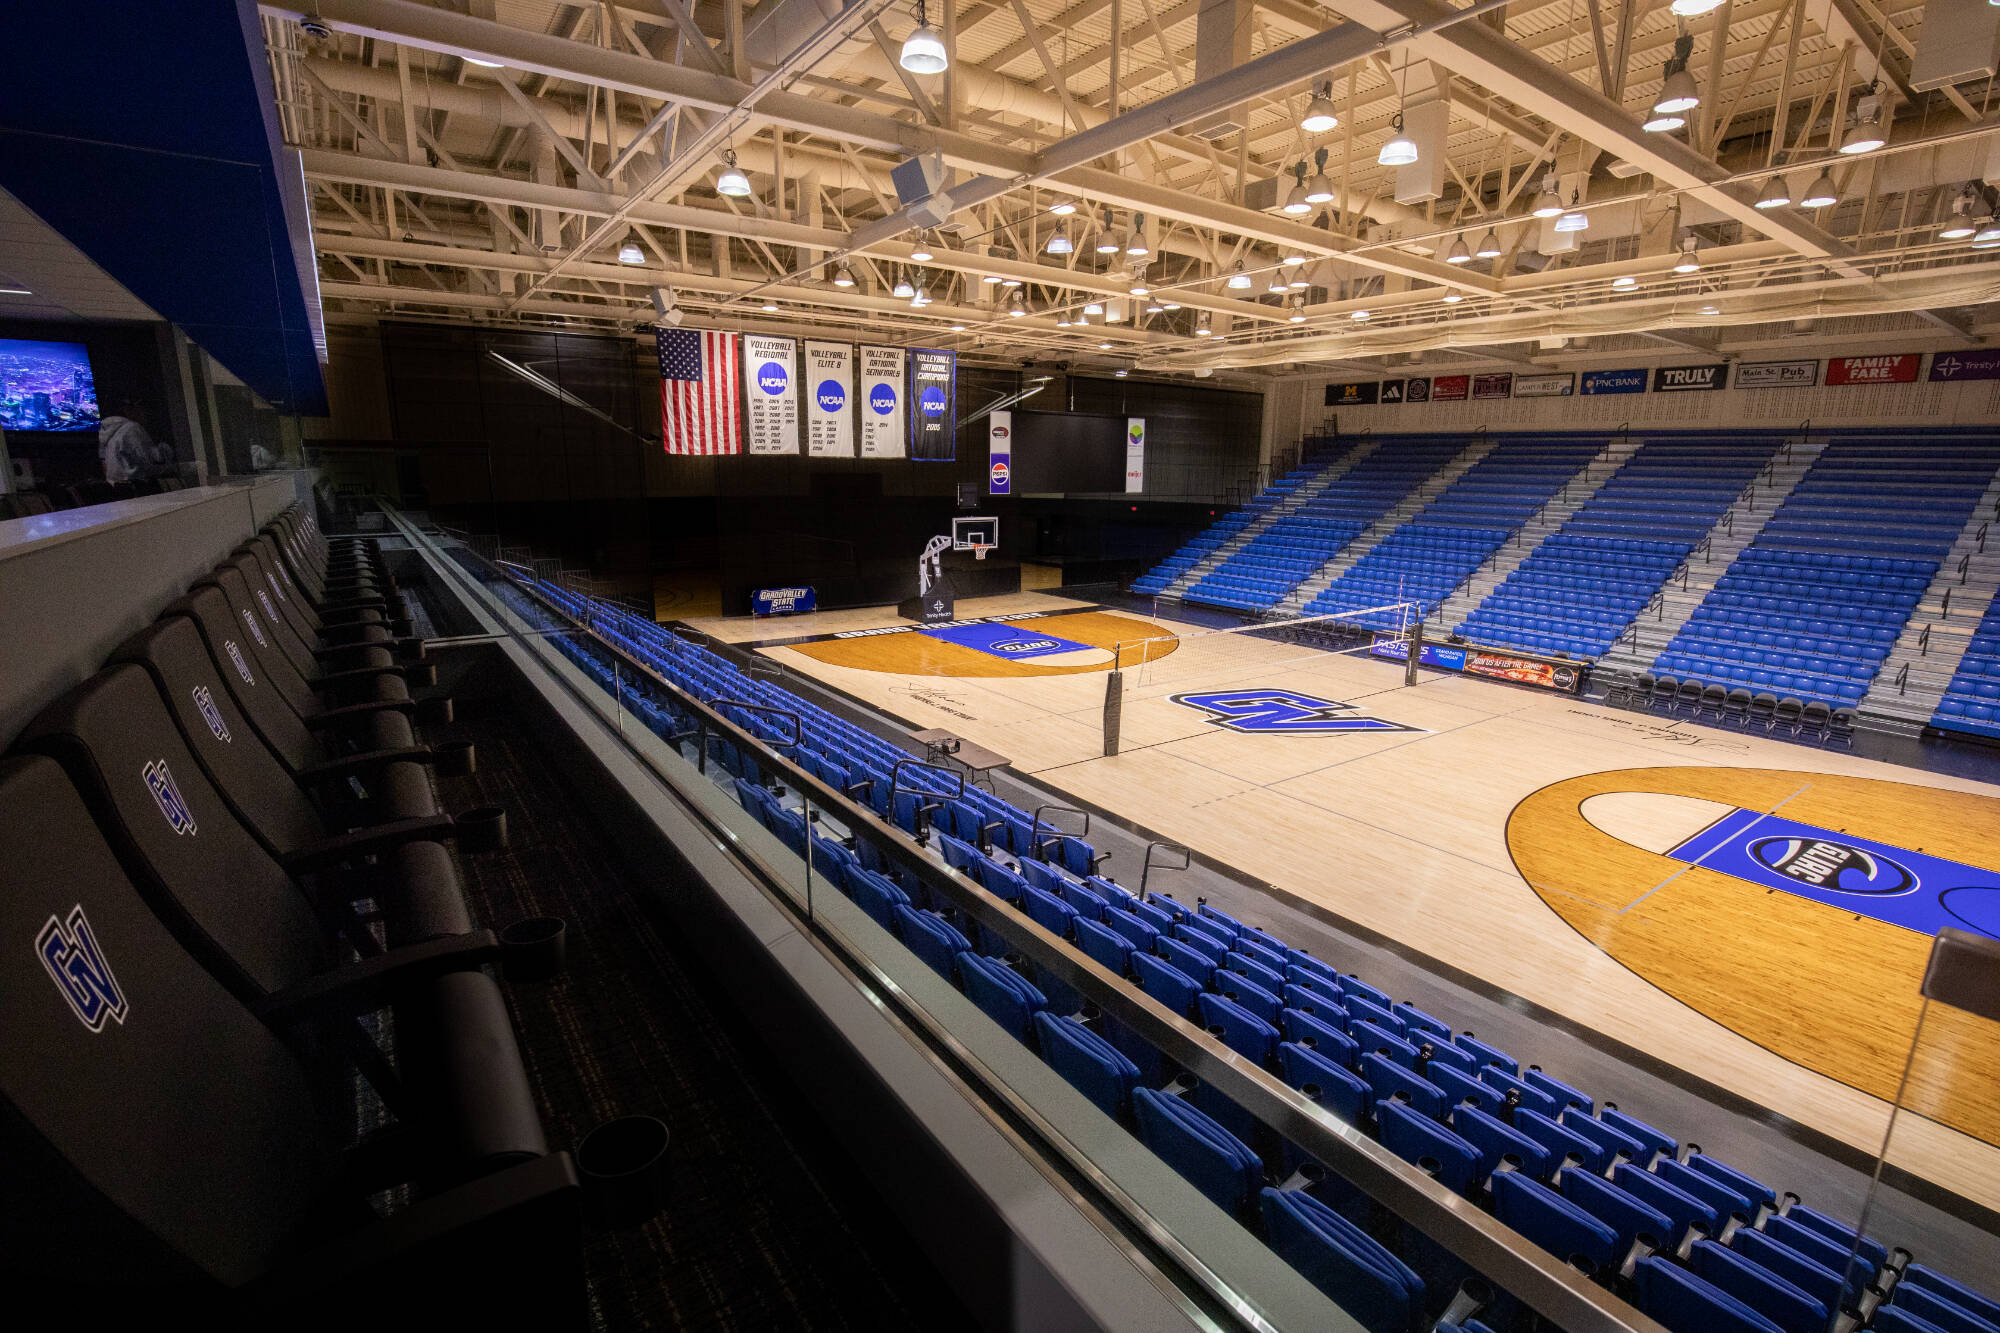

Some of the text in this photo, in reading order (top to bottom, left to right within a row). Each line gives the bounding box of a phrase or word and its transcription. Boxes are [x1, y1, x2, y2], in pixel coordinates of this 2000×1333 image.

[751, 340, 791, 350] VOLLEYBALL
[755, 350, 788, 359] REGIONAL
[811, 349, 847, 359] VOLLEYBALL
[866, 350, 900, 359] VOLLEYBALL
[869, 359, 897, 368] NATIONAL
[917, 354, 950, 364] VOLLEYBALL
[1844, 356, 1903, 369] FAMILY
[817, 360, 835, 368] ELITE
[921, 363, 947, 372] NATIONAL
[866, 368, 900, 377] SEMIFINALS
[917, 372, 949, 381] CHAMPIONS
[1664, 368, 1715, 384] TRULY
[1742, 369, 1761, 377] Main
[1782, 367, 1805, 376] Pub
[761, 377, 787, 388] NCAA
[820, 396, 843, 405] NCAA
[872, 399, 895, 408] NCAA
[923, 401, 945, 410] NCAA
[772, 597, 794, 607] STATE
[834, 626, 913, 639] GRAND
[912, 618, 987, 630] VALLEY
[1494, 660, 1511, 668] AFTER
[1512, 661, 1522, 669] THE
[1784, 841, 1852, 885] GLIAC
